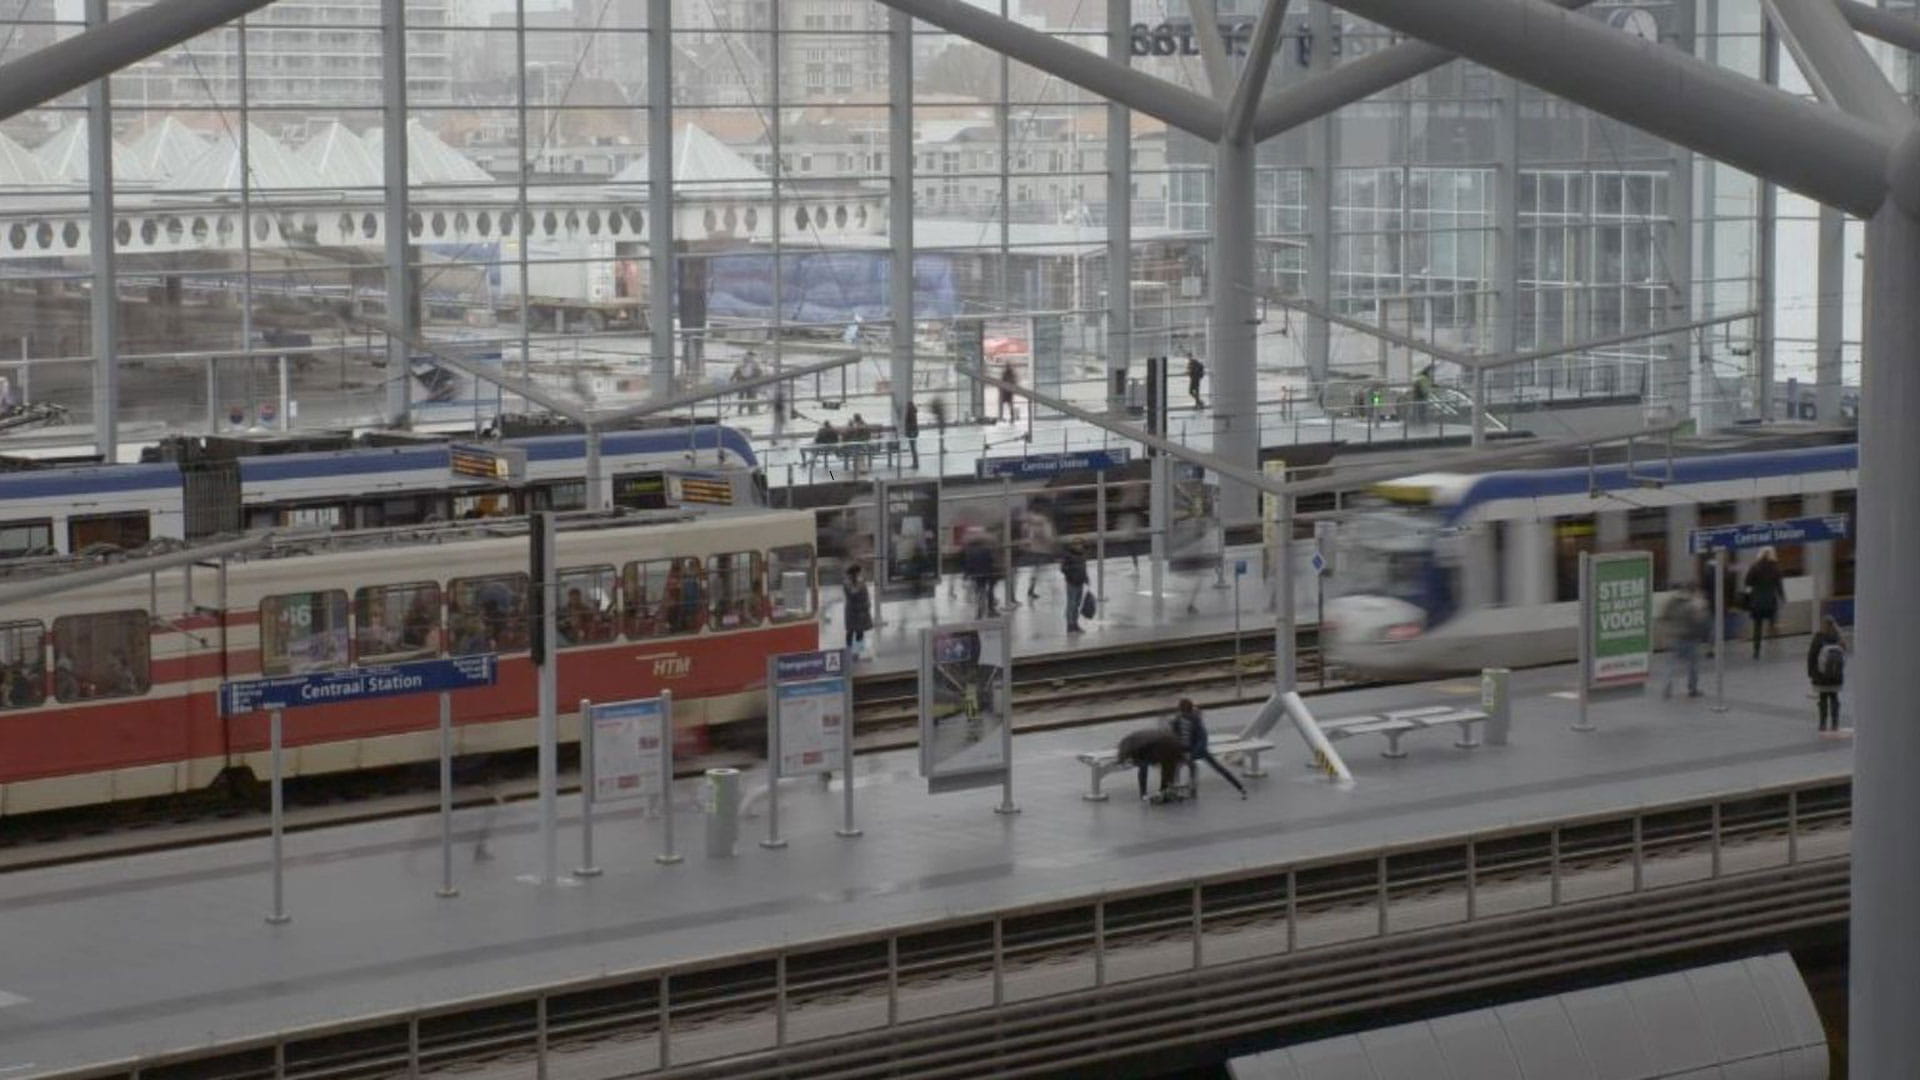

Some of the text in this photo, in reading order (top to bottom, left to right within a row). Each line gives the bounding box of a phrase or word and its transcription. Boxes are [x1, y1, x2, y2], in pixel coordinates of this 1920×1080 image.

[1599, 578, 1645, 601] STEM
[1599, 610, 1646, 631] VOOR
[652, 656, 692, 676] HTM
[301, 677, 364, 700] Centraal
[367, 673, 423, 694] Station
